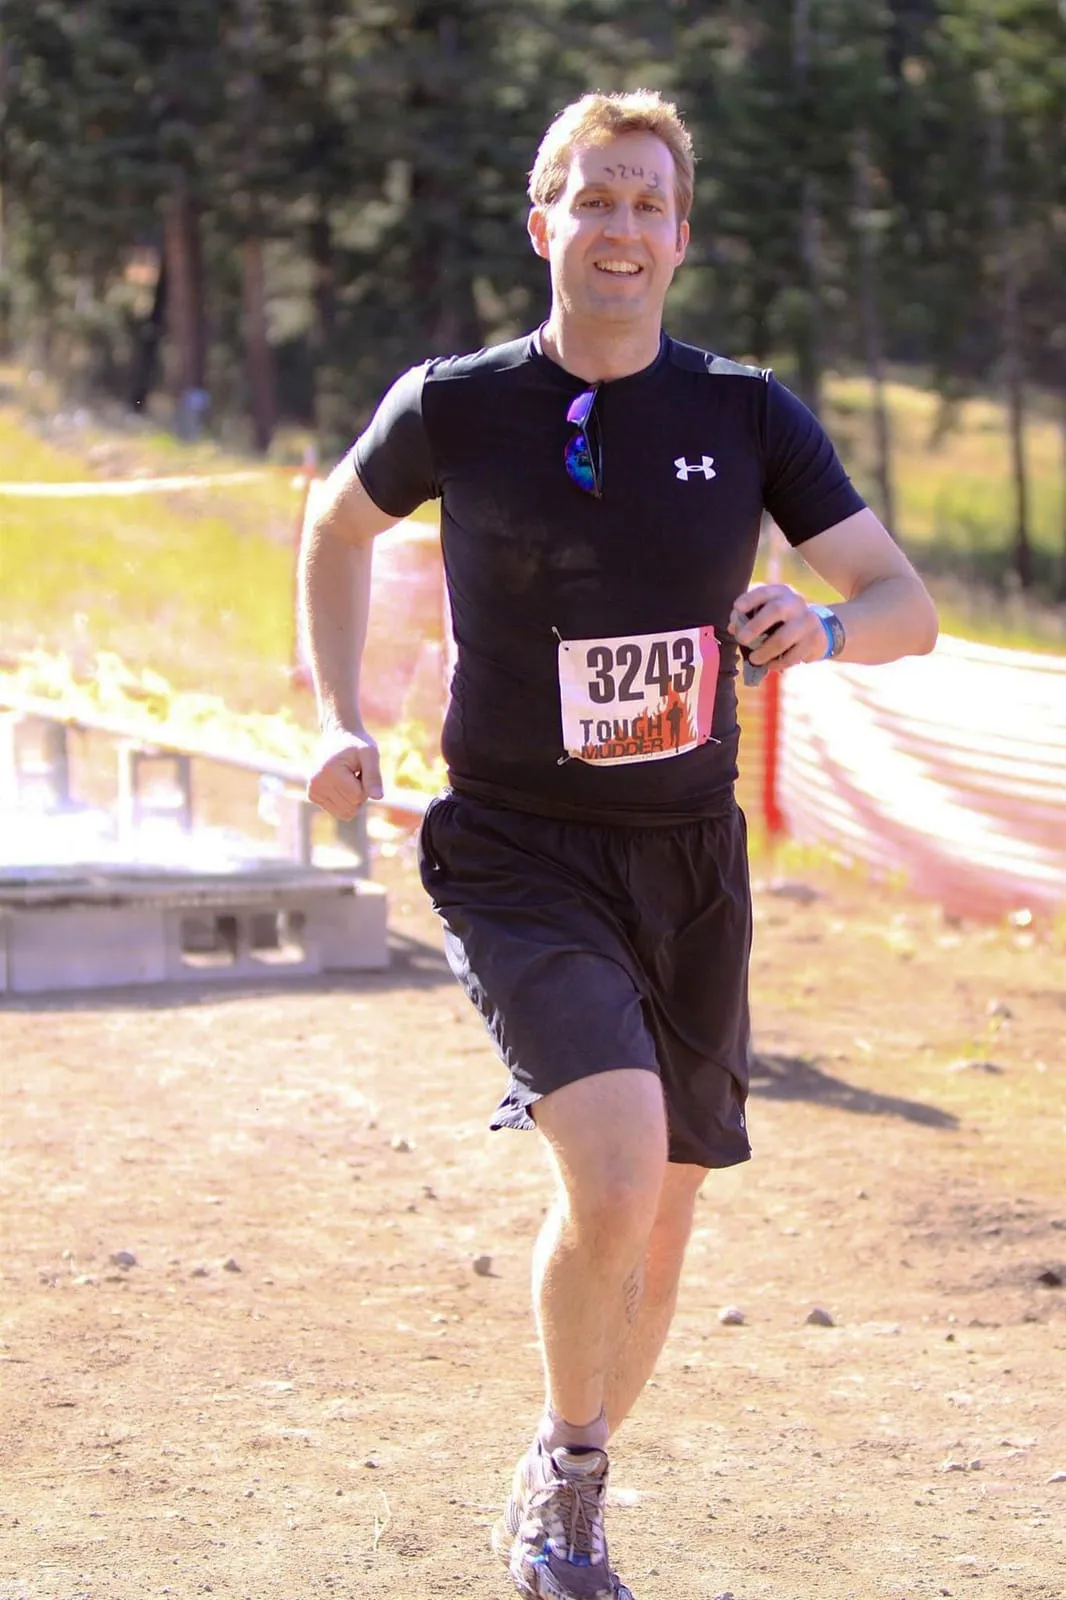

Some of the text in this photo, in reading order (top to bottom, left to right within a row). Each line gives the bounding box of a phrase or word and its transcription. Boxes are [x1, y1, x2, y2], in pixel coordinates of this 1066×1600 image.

[586, 637, 696, 704] 3243
[579, 714, 663, 745] TOUGH
[581, 738, 664, 760] MUDDER
